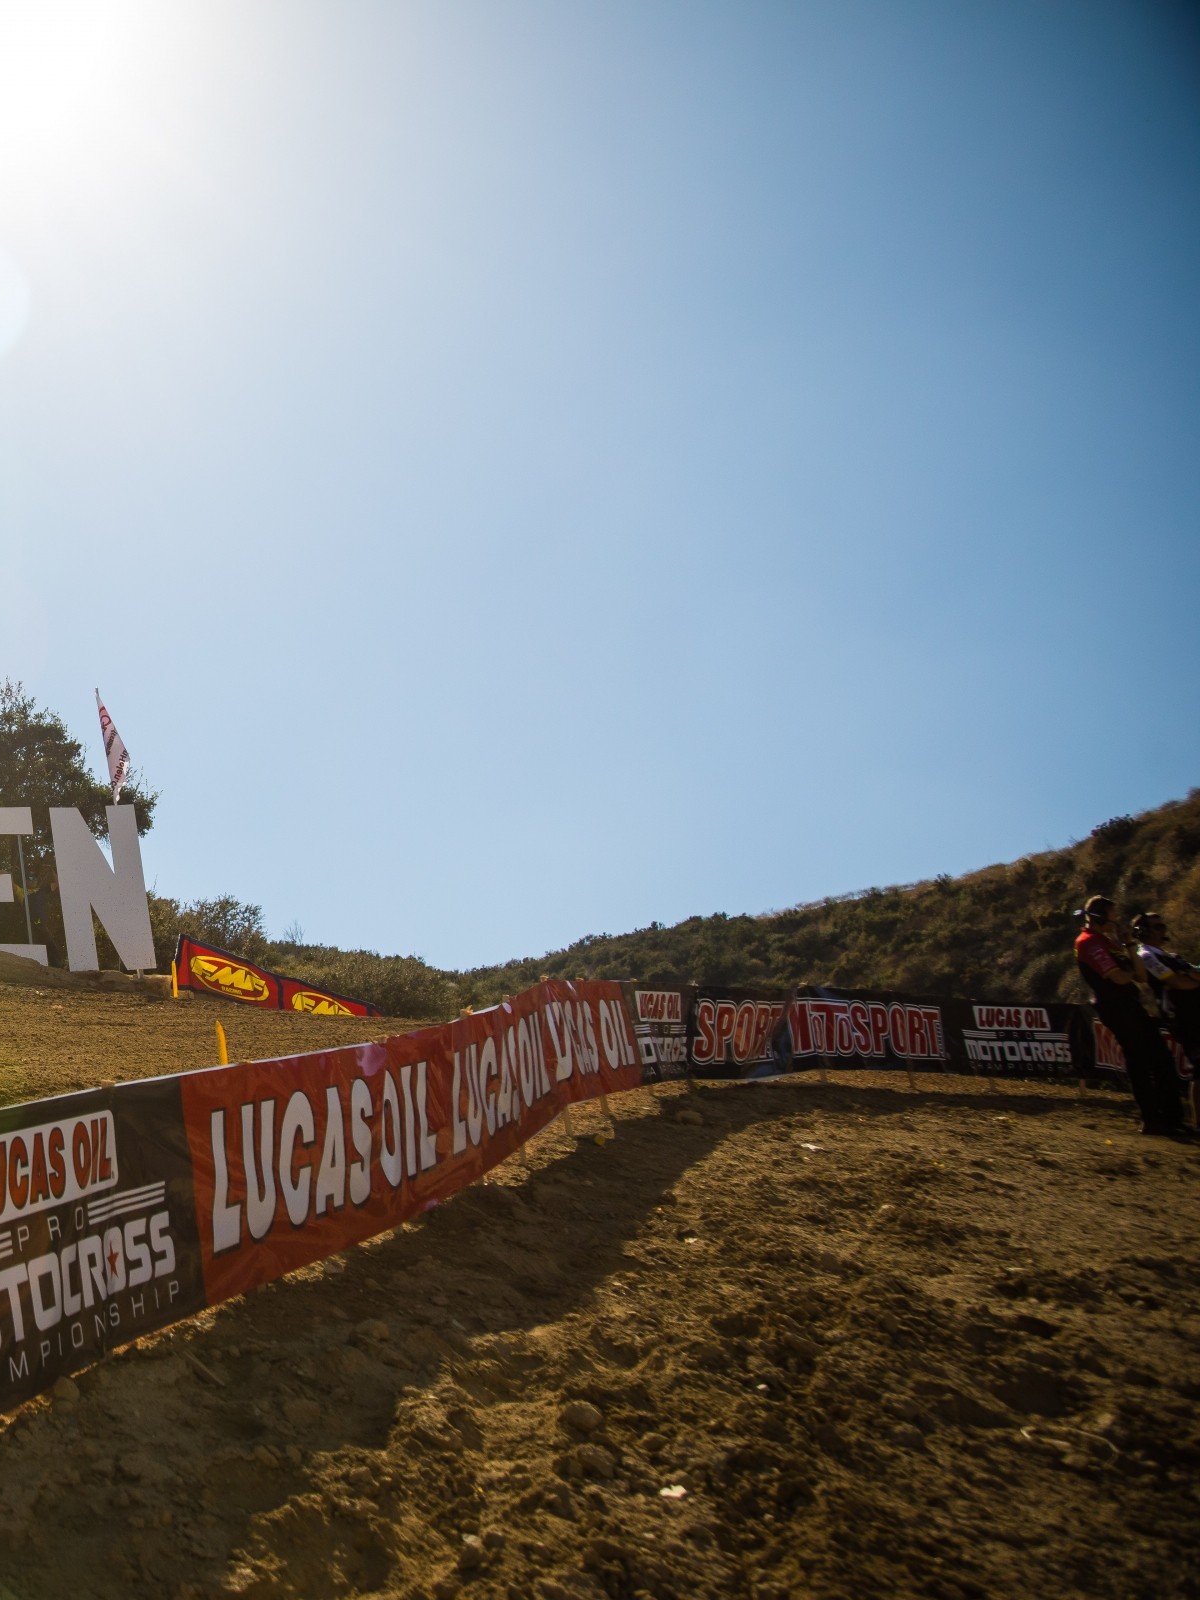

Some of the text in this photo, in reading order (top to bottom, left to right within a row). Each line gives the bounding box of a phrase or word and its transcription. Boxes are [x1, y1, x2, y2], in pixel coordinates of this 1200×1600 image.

[192, 958, 267, 992] FMF
[295, 993, 348, 1016] FM
[667, 994, 680, 1020] OIL
[977, 1007, 1048, 1029] LUCAS OIL
[600, 999, 636, 1071] OIL
[963, 1038, 1073, 1063] MOTOCROSS
[518, 1010, 551, 1108] OIL
[72, 1116, 113, 1190] OIL
[211, 1060, 437, 1254] LUCAS OIL
[17, 1205, 86, 1252] PRO
